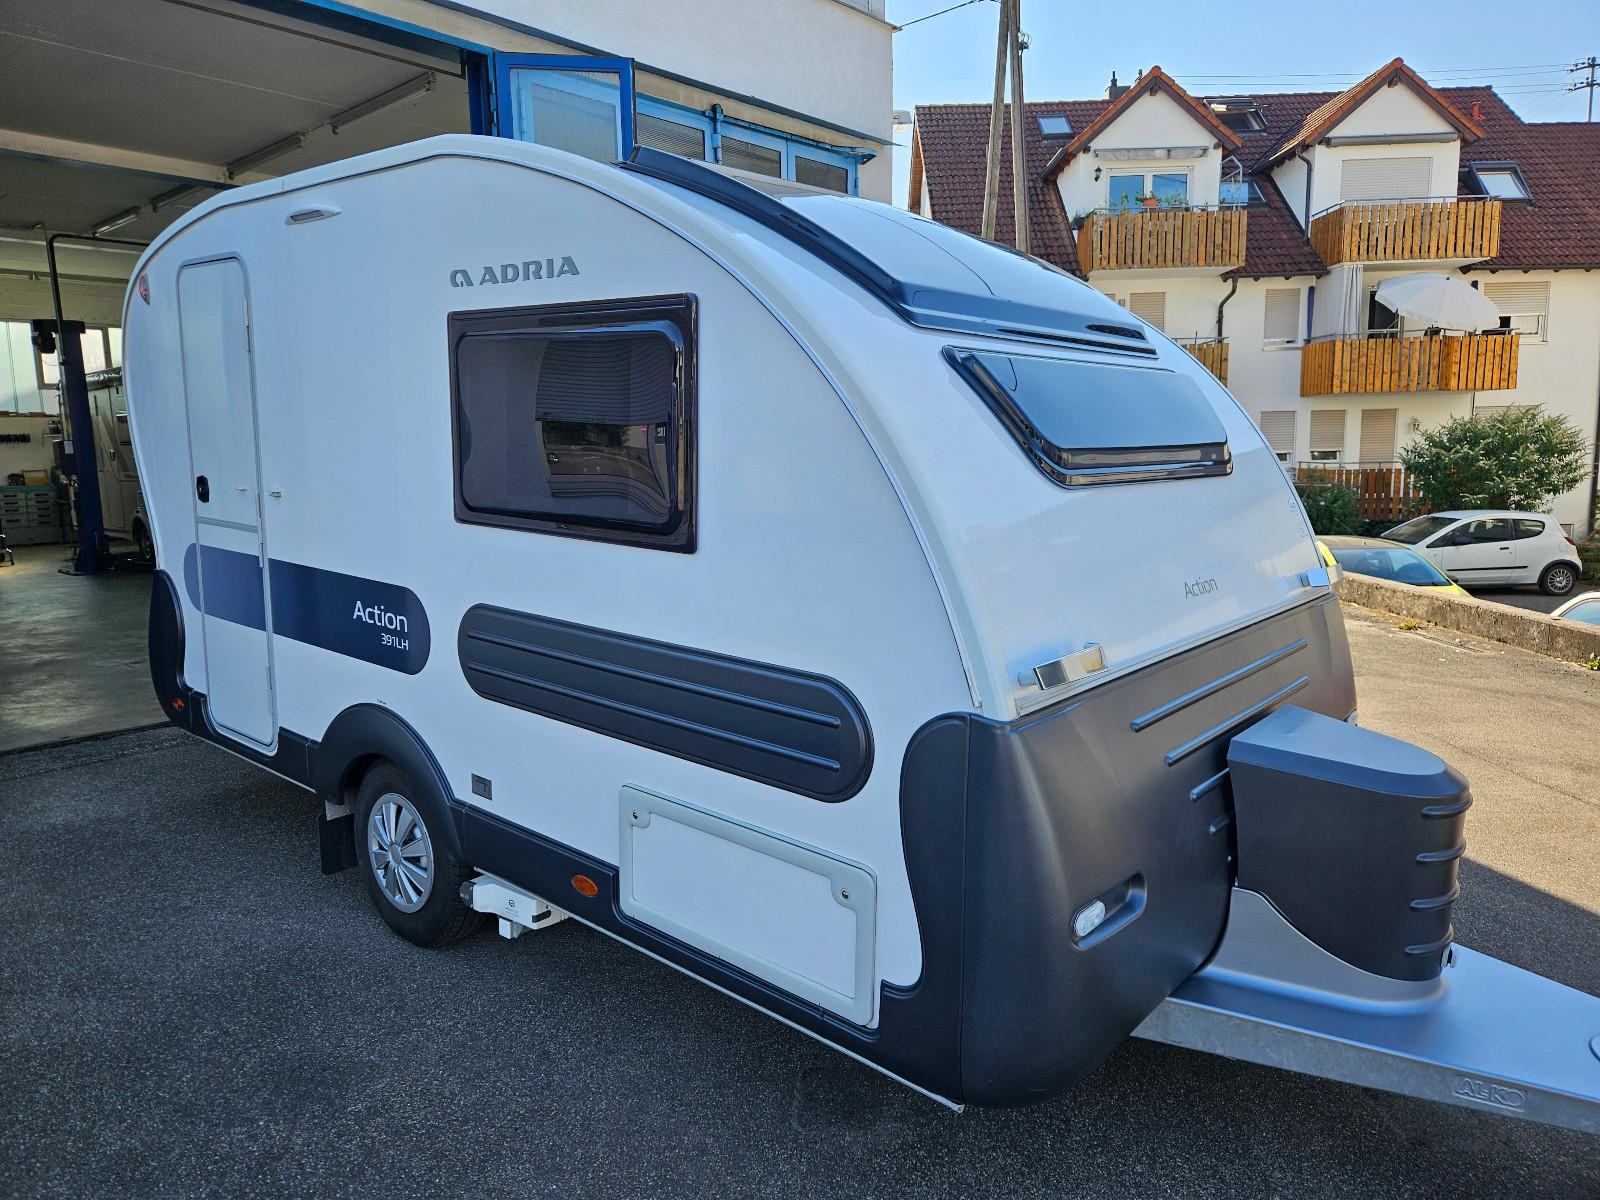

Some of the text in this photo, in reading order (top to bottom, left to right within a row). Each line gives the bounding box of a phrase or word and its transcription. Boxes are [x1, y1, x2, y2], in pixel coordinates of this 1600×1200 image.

[479, 256, 580, 285] ADRIA
[1184, 577, 1219, 599] Action
[353, 600, 408, 633] Action
[380, 632, 409, 651] 391LH
